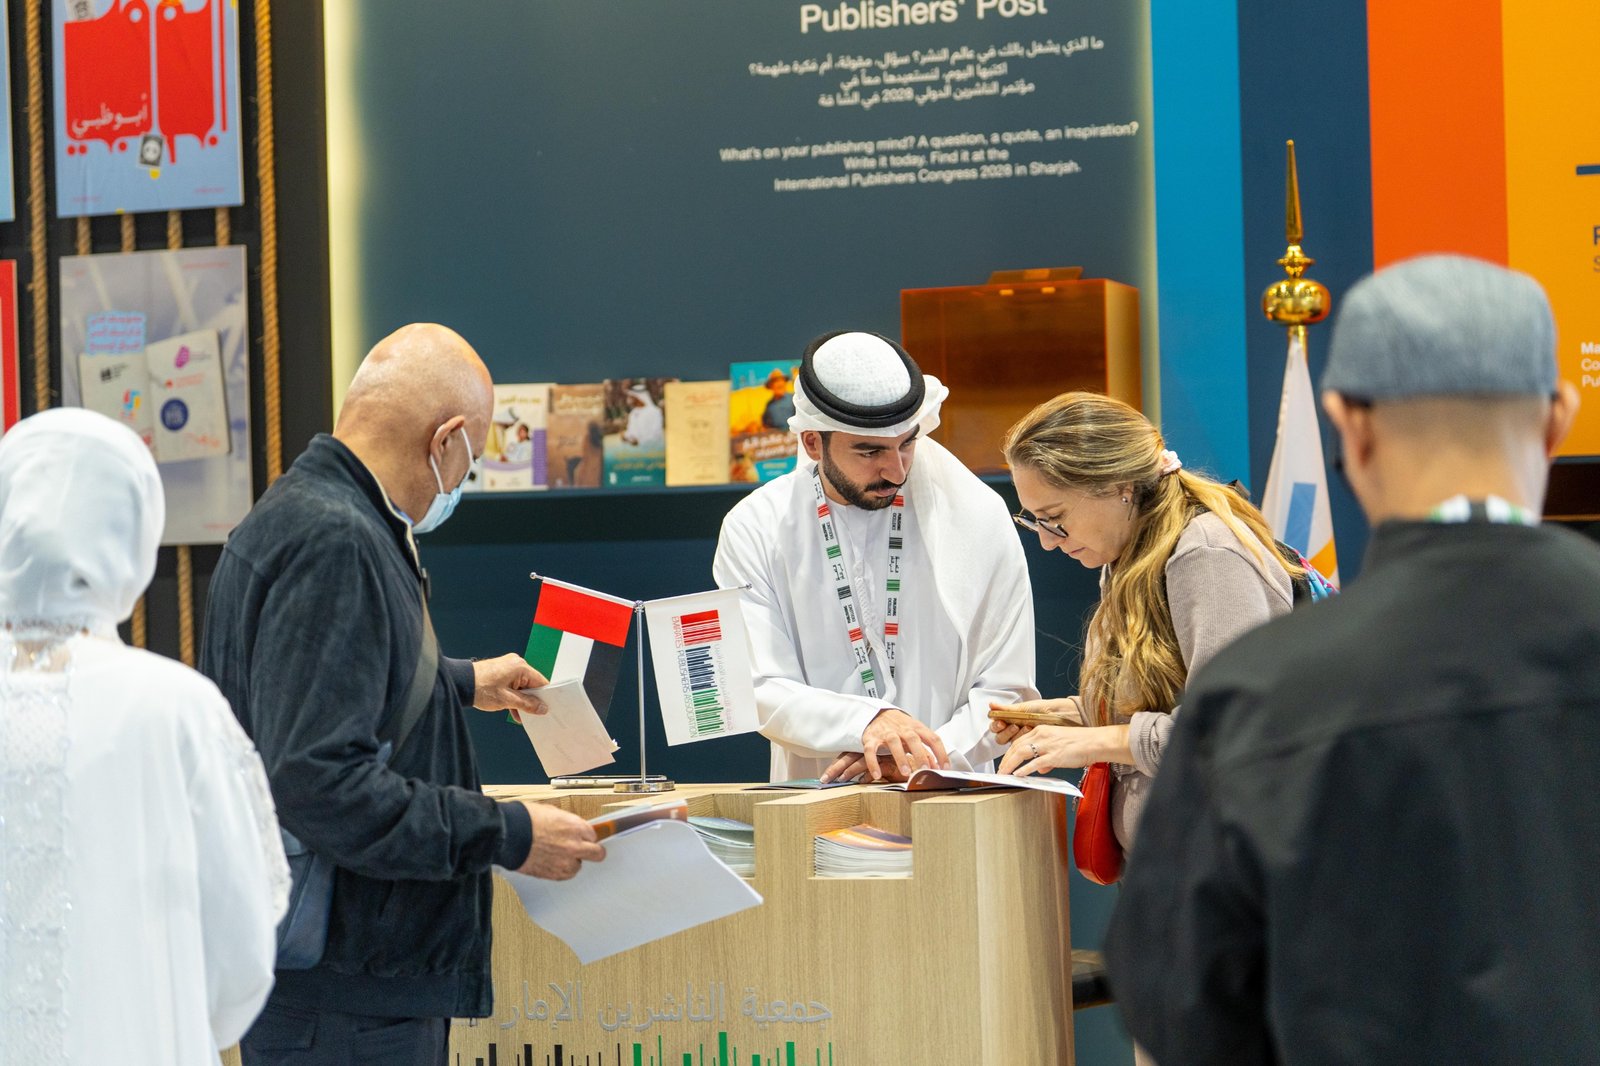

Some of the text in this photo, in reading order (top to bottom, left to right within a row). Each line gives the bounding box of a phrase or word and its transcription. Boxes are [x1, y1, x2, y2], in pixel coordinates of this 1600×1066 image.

[800, 0, 1048, 33] Publishers' Post
[917, 134, 929, 149] A
[672, 616, 699, 738] EMIRATES PUBLISHERS ASSOCIATION
[599, 980, 725, 1032] الناشرين
[741, 986, 832, 1030] جمعية
